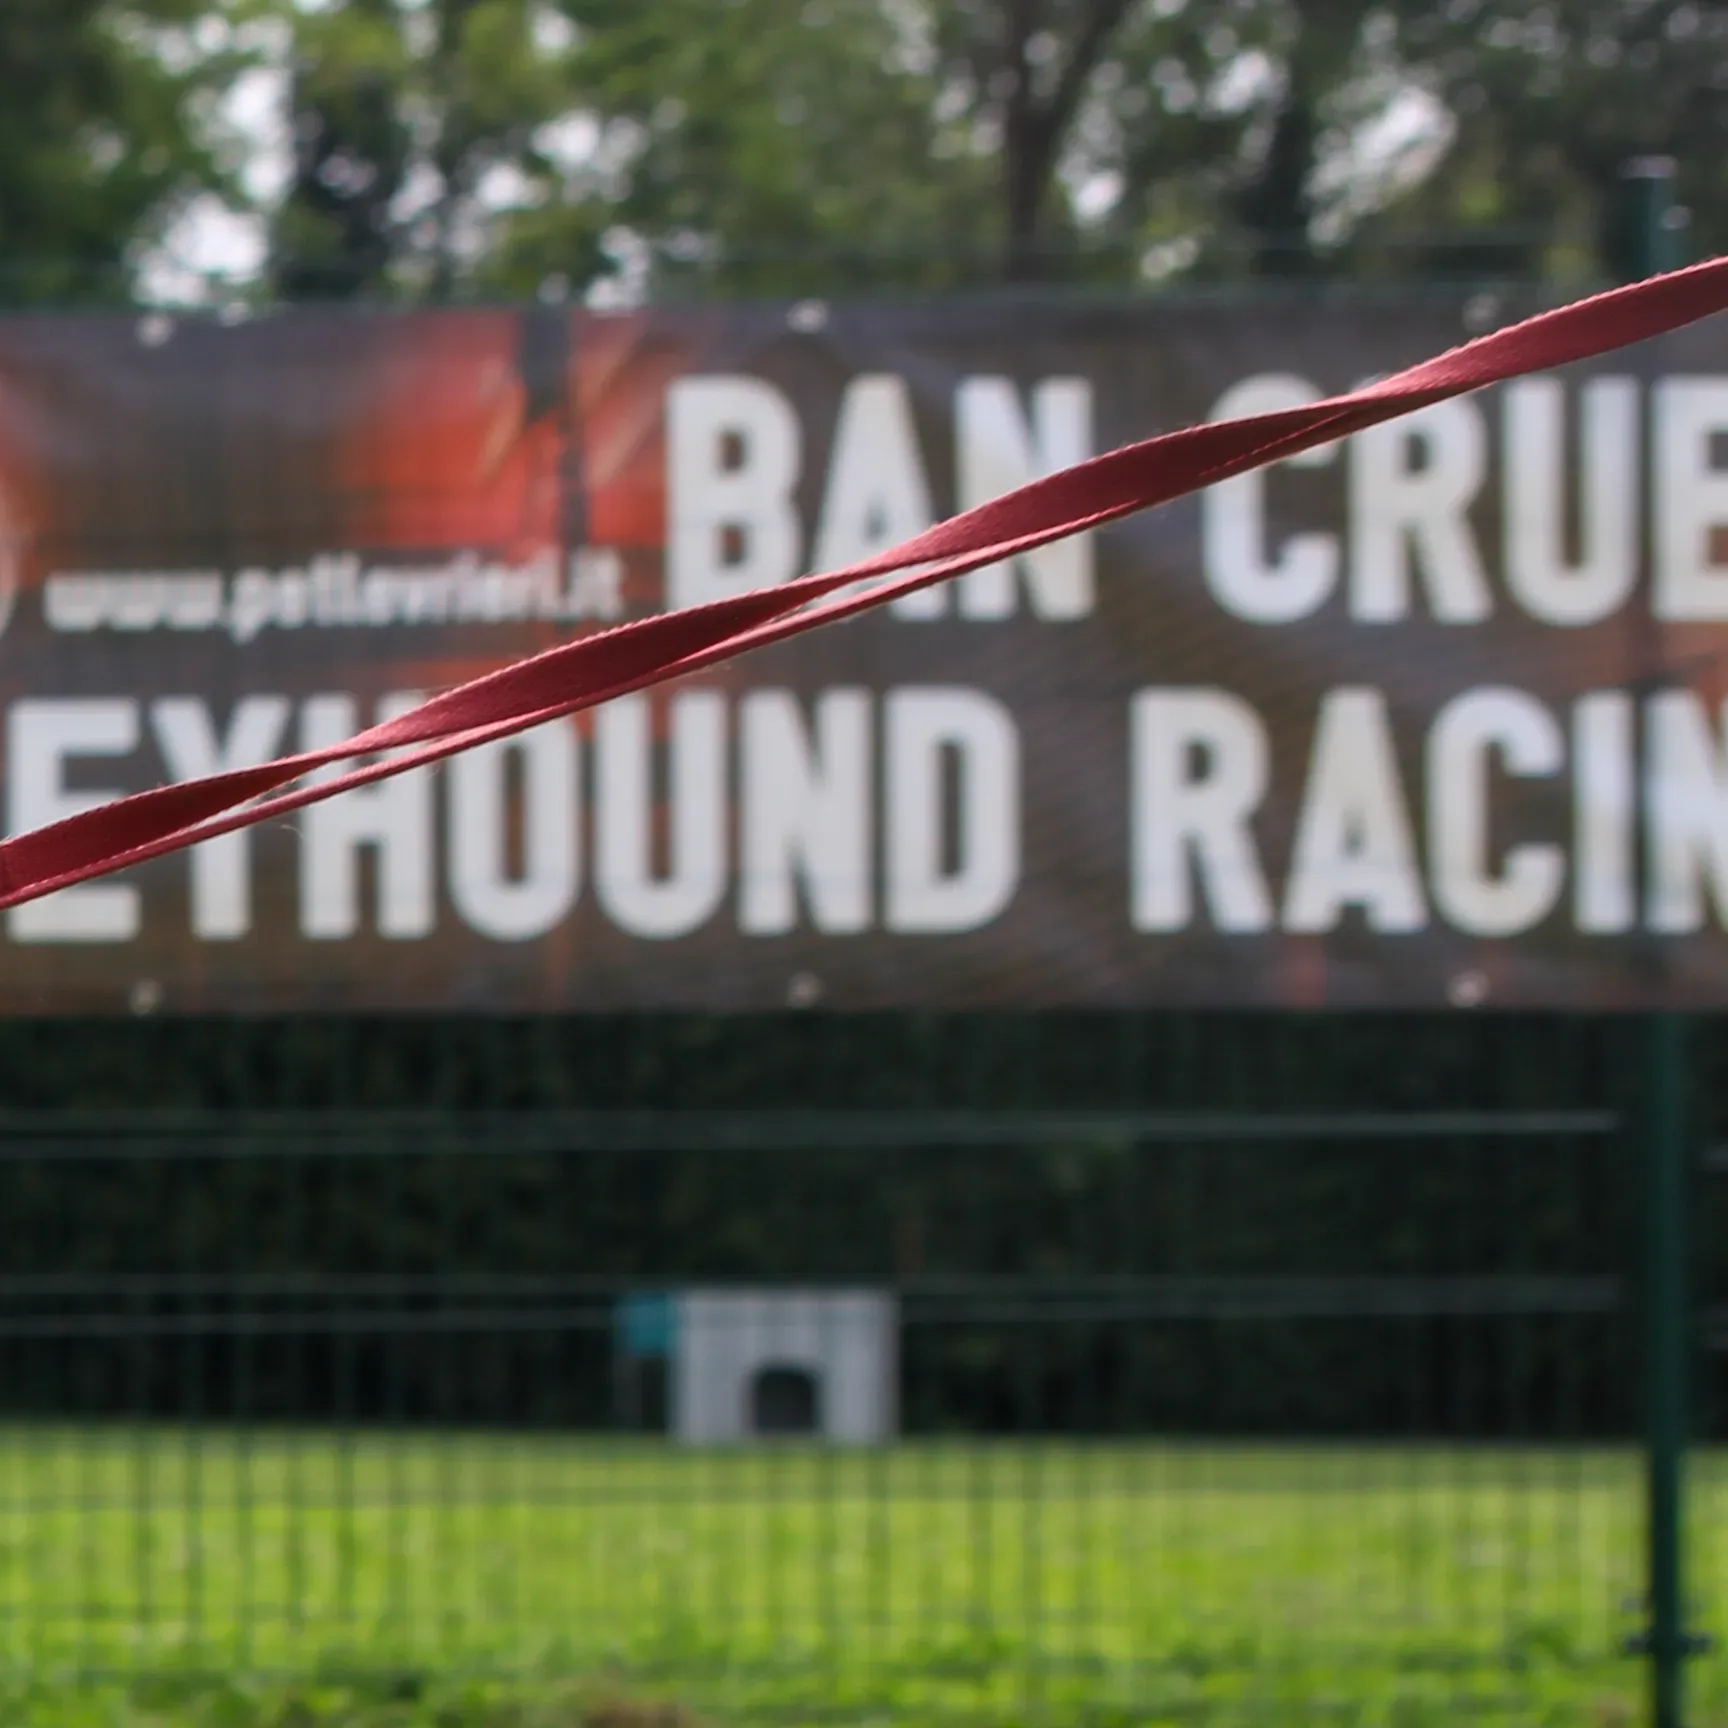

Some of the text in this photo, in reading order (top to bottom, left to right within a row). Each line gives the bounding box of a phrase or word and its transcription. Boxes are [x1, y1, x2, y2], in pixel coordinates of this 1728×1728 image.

[666, 374, 1728, 626] BAN CRUE
[1130, 684, 1728, 940] RACIN
